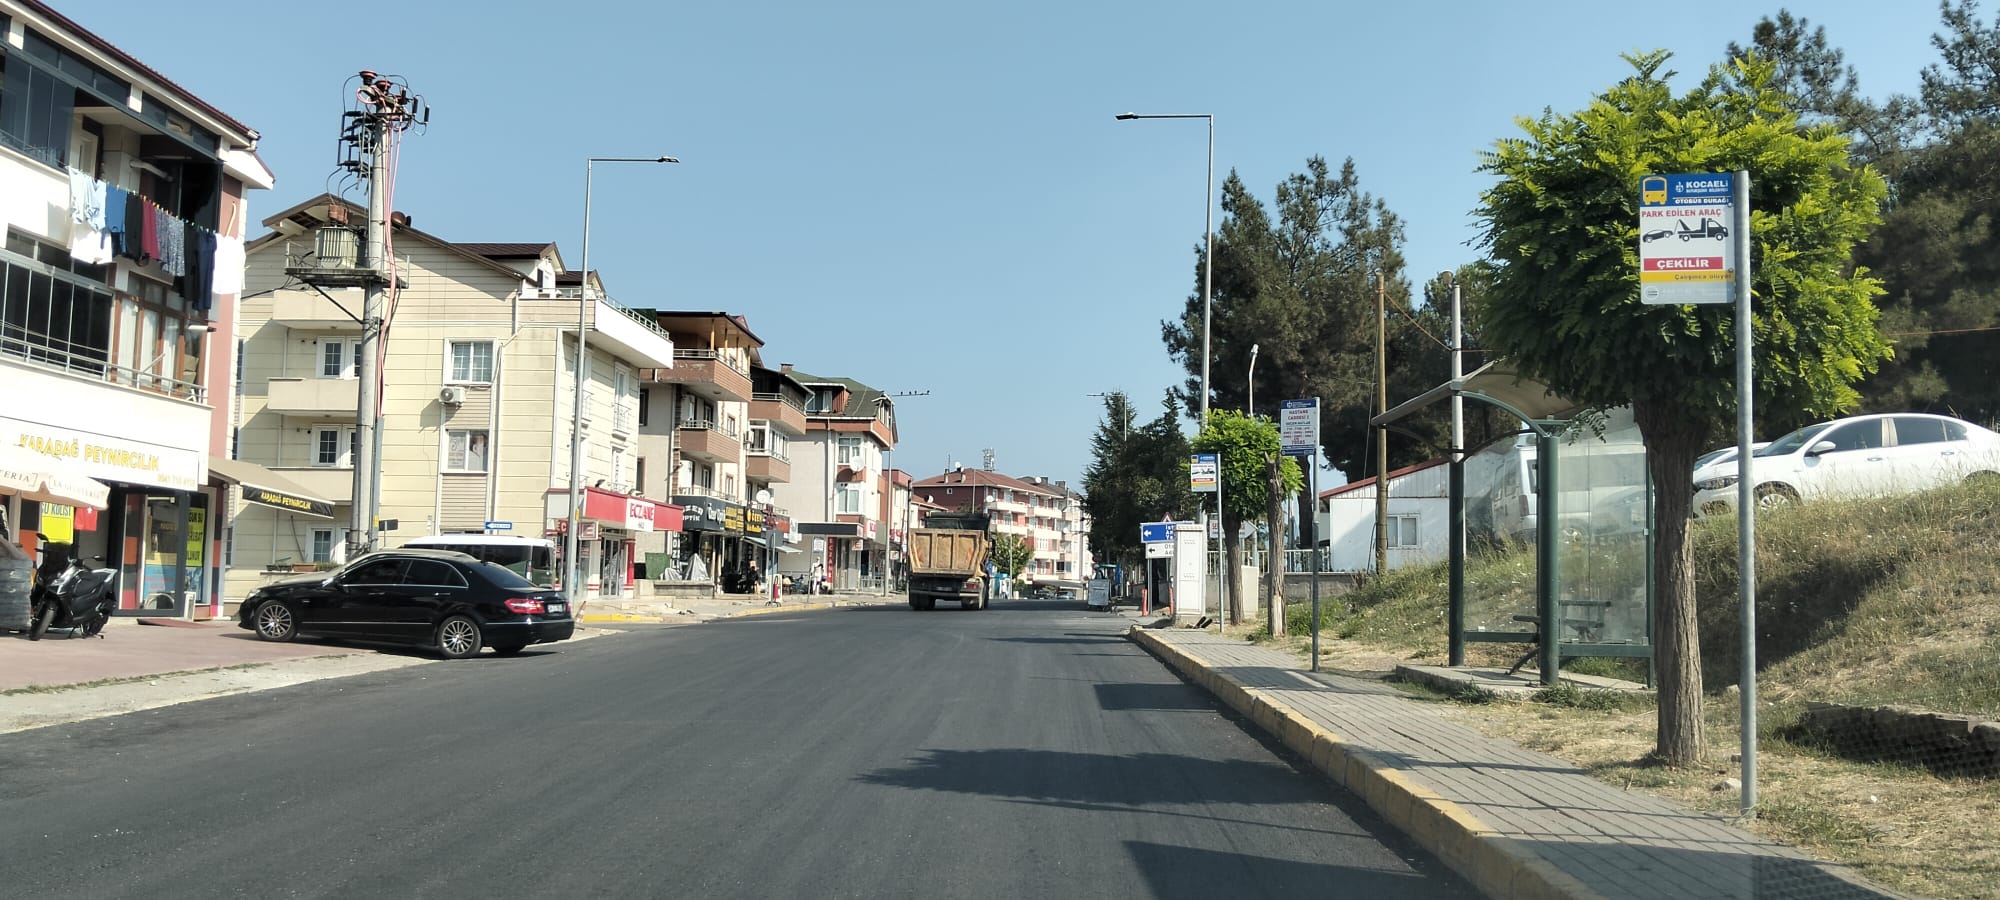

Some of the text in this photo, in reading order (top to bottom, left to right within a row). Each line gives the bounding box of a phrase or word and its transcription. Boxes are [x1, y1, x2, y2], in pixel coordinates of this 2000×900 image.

[1666, 208, 1696, 217] EDİLEN
[1698, 208, 1721, 217] ARAÇ
[1657, 258, 1709, 271] ÇEKİLİR
[20, 434, 159, 471] KARADAĞ PEYNİRCİLİK
[629, 502, 654, 521] ECZANE
